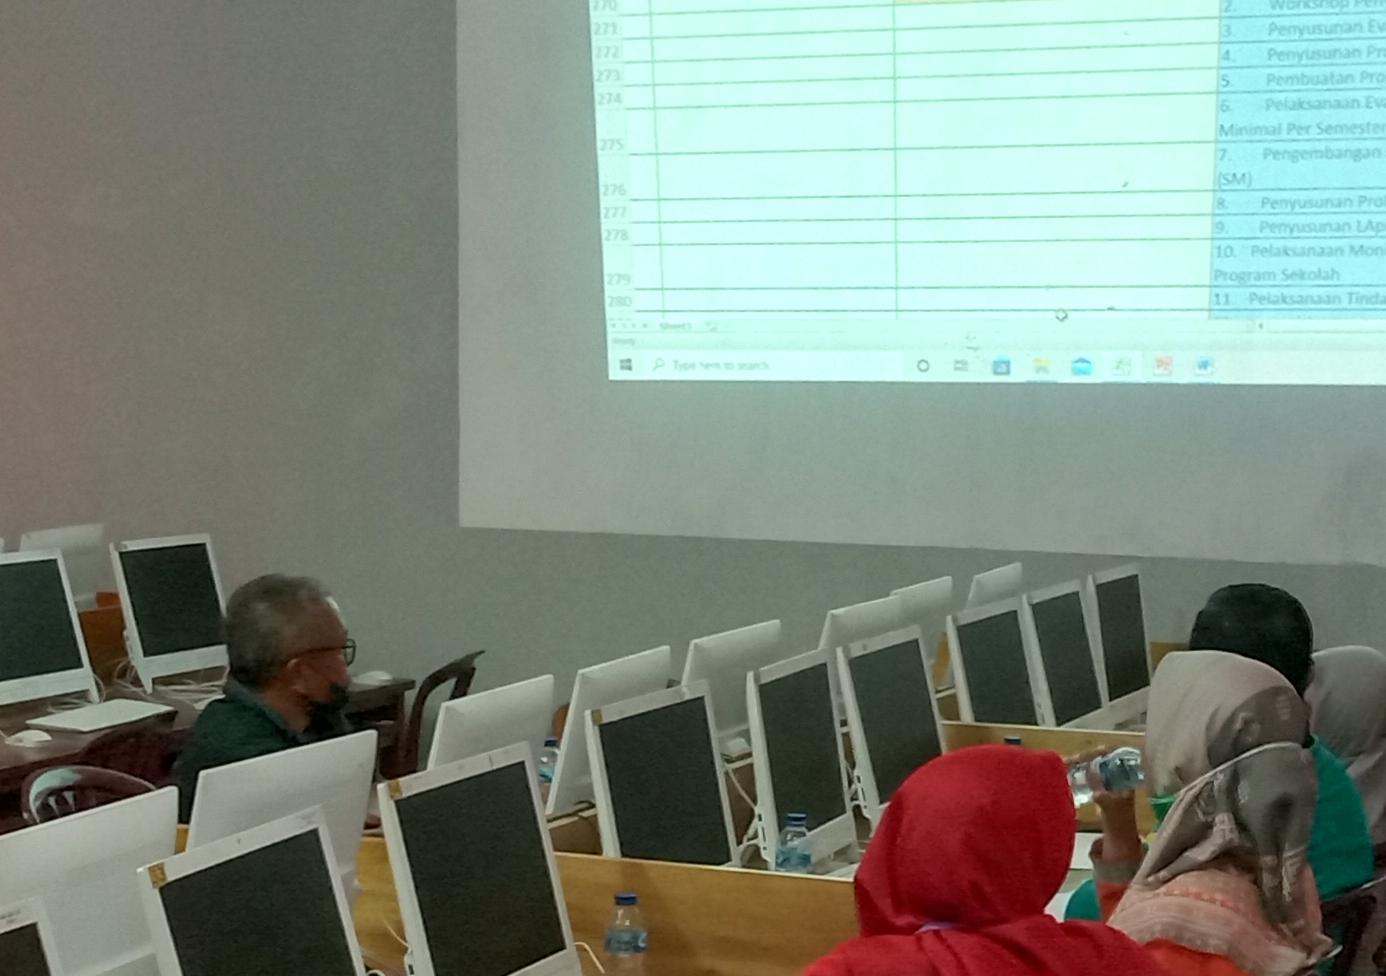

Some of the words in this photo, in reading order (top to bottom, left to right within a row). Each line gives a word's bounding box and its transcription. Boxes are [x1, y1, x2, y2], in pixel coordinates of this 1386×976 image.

[594, 22, 618, 35] 271
[1268, 21, 1363, 38] Penyusunan
[595, 46, 619, 59] 272
[1267, 46, 1363, 63] Penyusunan
[596, 69, 621, 83] 273
[1266, 71, 1355, 87] Pembuatan
[597, 92, 622, 106] 274
[1265, 97, 1361, 112] Pelaksanaan
[1219, 122, 1282, 137] Minimal
[1286, 122, 1311, 136] Per
[599, 138, 624, 152] 275
[1263, 146, 1382, 164] Pengembangan
[602, 183, 627, 197] 276
[1261, 196, 1354, 212] Penyusunan
[603, 206, 627, 219] 277
[1259, 220, 1353, 235] Penyusunan
[604, 229, 629, 242] 278
[1250, 243, 1344, 258] Pelaksanaan
[606, 273, 631, 286] 279
[1213, 268, 1277, 284] Program
[1281, 267, 1341, 282] Sekolah
[1249, 291, 1342, 306] Pelaksanaan
[673, 359, 696, 372] Type
[737, 360, 770, 371] search
